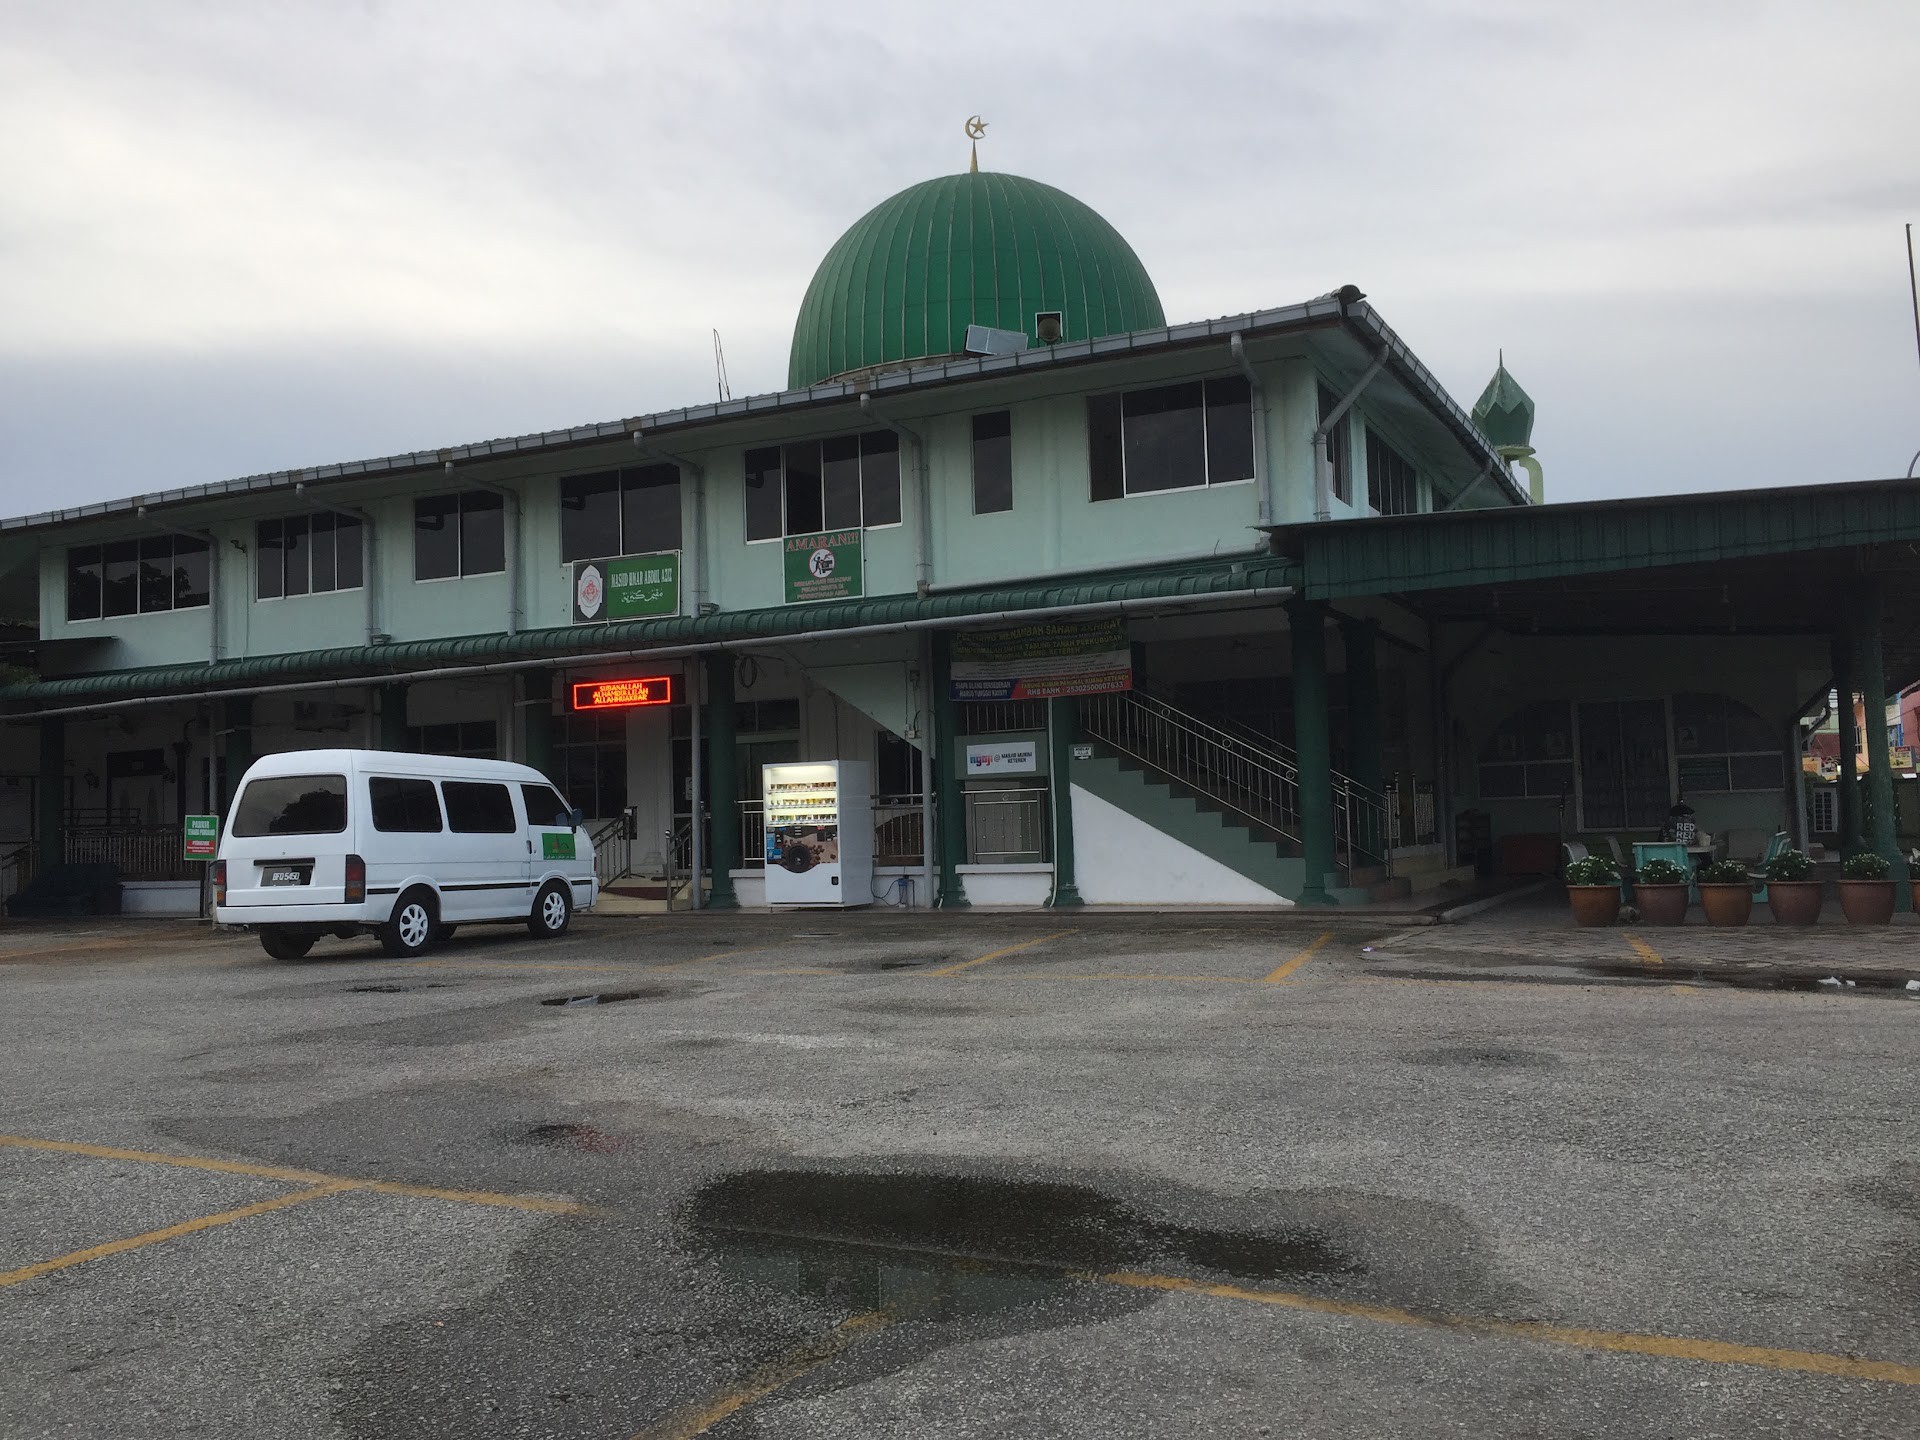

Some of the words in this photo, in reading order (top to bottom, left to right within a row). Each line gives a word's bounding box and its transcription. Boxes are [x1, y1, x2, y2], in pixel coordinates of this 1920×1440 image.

[785, 532, 859, 552] AMARAN!!!
[611, 573, 628, 588] MASJID
[629, 571, 643, 586] UMAR
[644, 569, 660, 585] ABDUL
[661, 568, 672, 583] AZIZ
[1046, 624, 1077, 635] SAHAM
[1042, 686, 1060, 694] BANK
[970, 753, 993, 766] ngaji
[1676, 822, 1695, 831] RED
